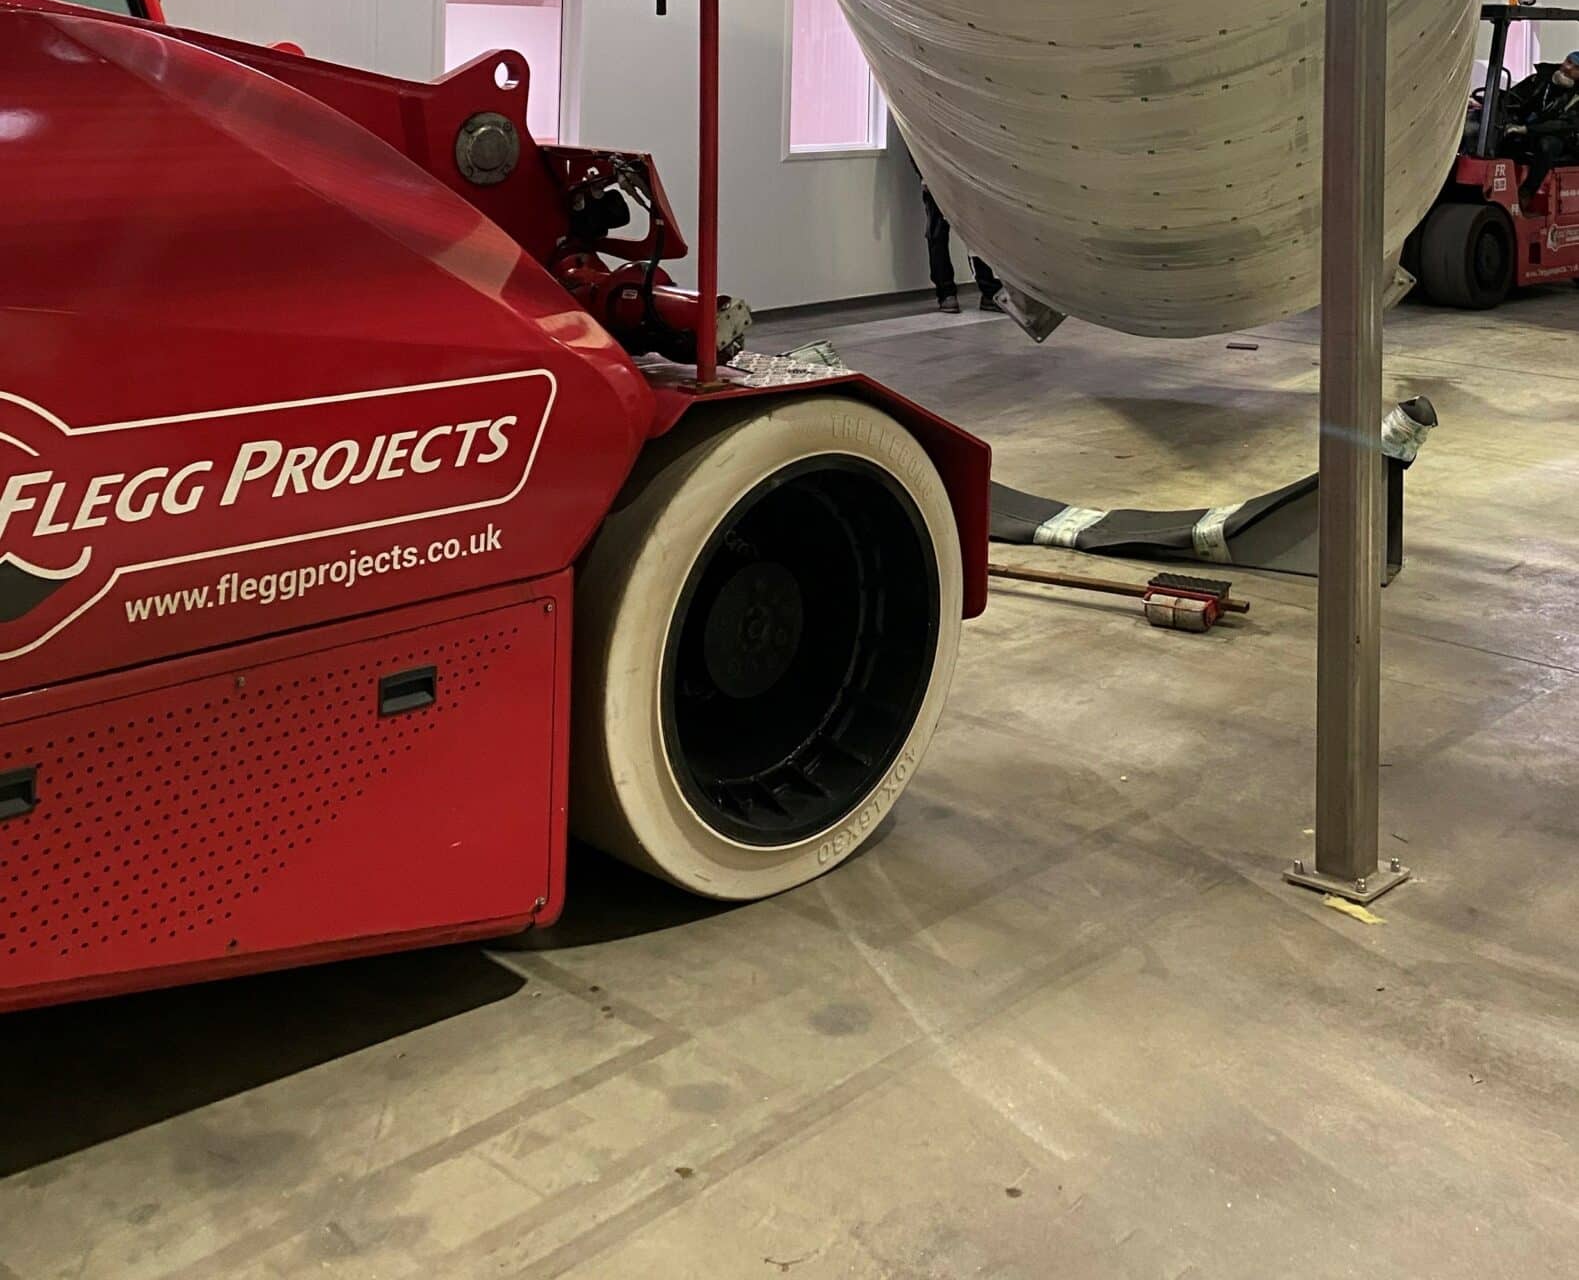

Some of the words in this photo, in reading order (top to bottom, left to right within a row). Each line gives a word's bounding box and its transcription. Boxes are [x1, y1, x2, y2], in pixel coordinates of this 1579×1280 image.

[0, 460, 213, 540] FLEGG
[219, 415, 518, 506] PROJECTS
[125, 523, 503, 622] www.fleggprojects.co.uk
